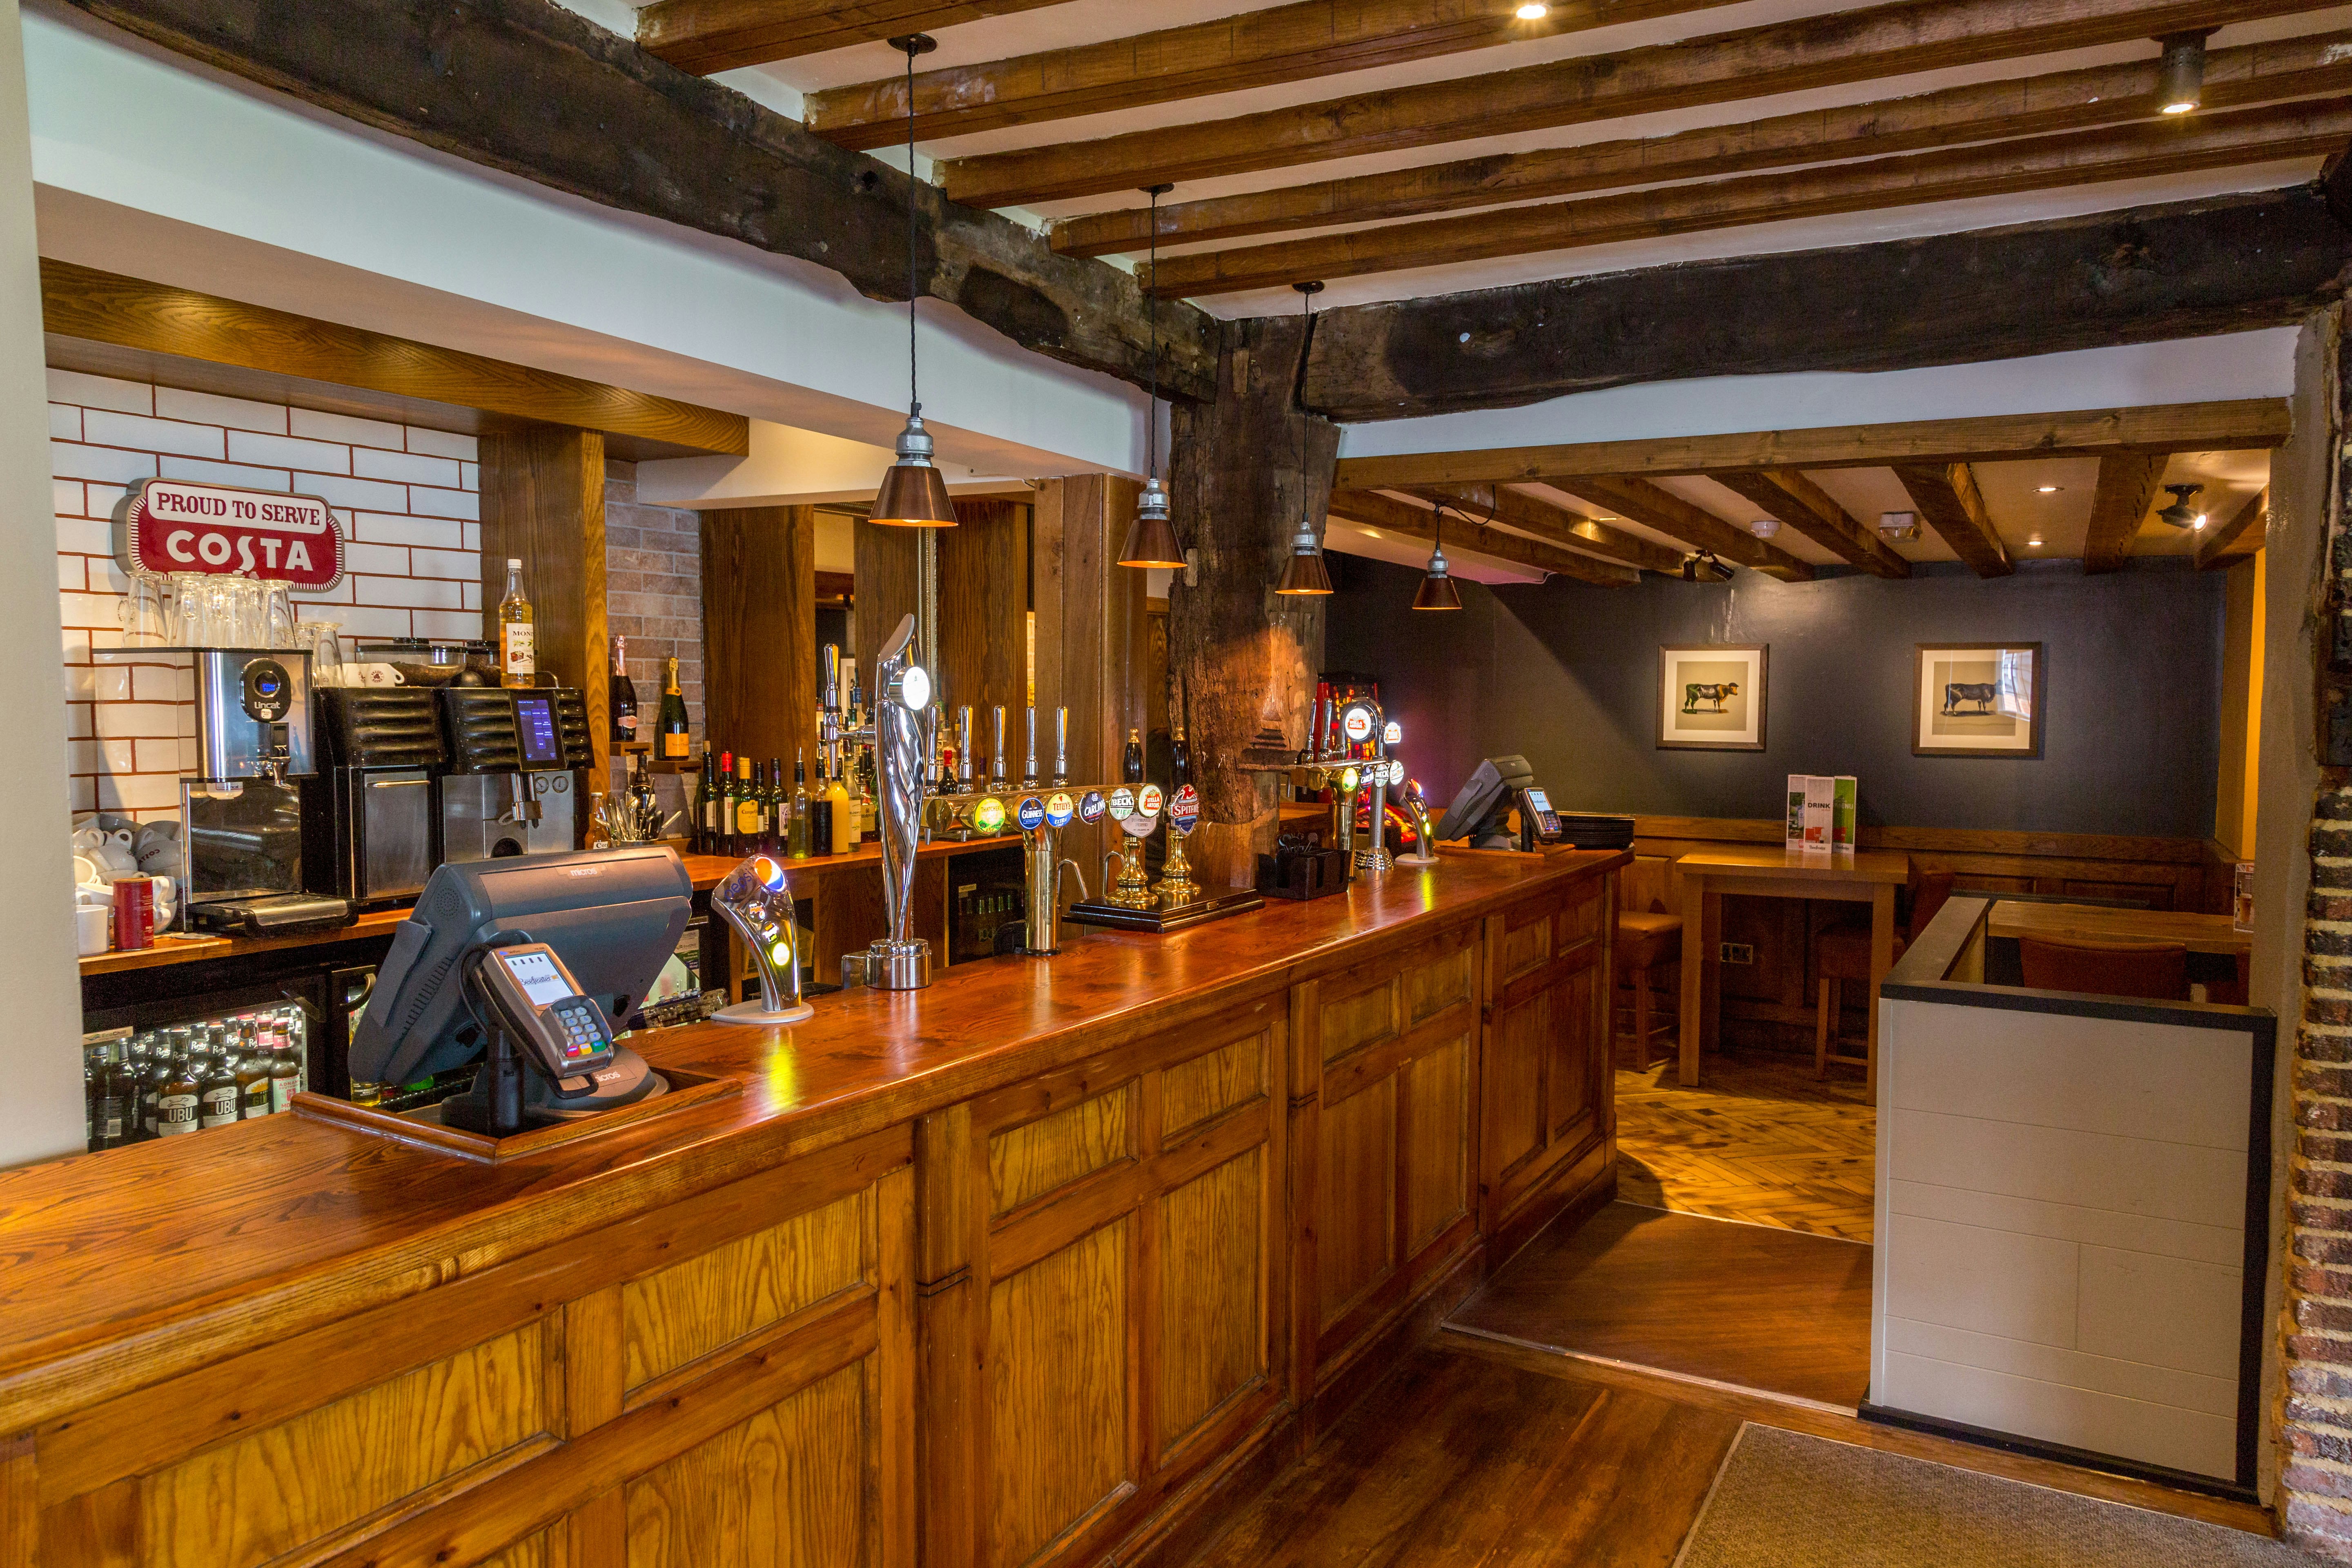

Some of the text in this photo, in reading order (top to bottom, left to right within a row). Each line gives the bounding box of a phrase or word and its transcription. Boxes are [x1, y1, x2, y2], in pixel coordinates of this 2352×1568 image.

[156, 492, 320, 526] PROUD TO SERVE
[167, 530, 313, 572] COSTA
[1021, 809, 1043, 819] GUINNESS
[1174, 802, 1199, 816] SPITFIRE
[570, 868, 597, 876] micros
[724, 868, 754, 903] pepsi
[518, 976, 551, 985] Beefeater
[132, 1043, 146, 1054] Purity
[191, 1041, 207, 1051] Purity
[213, 1045, 227, 1056] Purity
[156, 1047, 171, 1058] Purity
[173, 1051, 188, 1062] Purity
[216, 1098, 236, 1115] UBU
[169, 1107, 192, 1123] UBU
